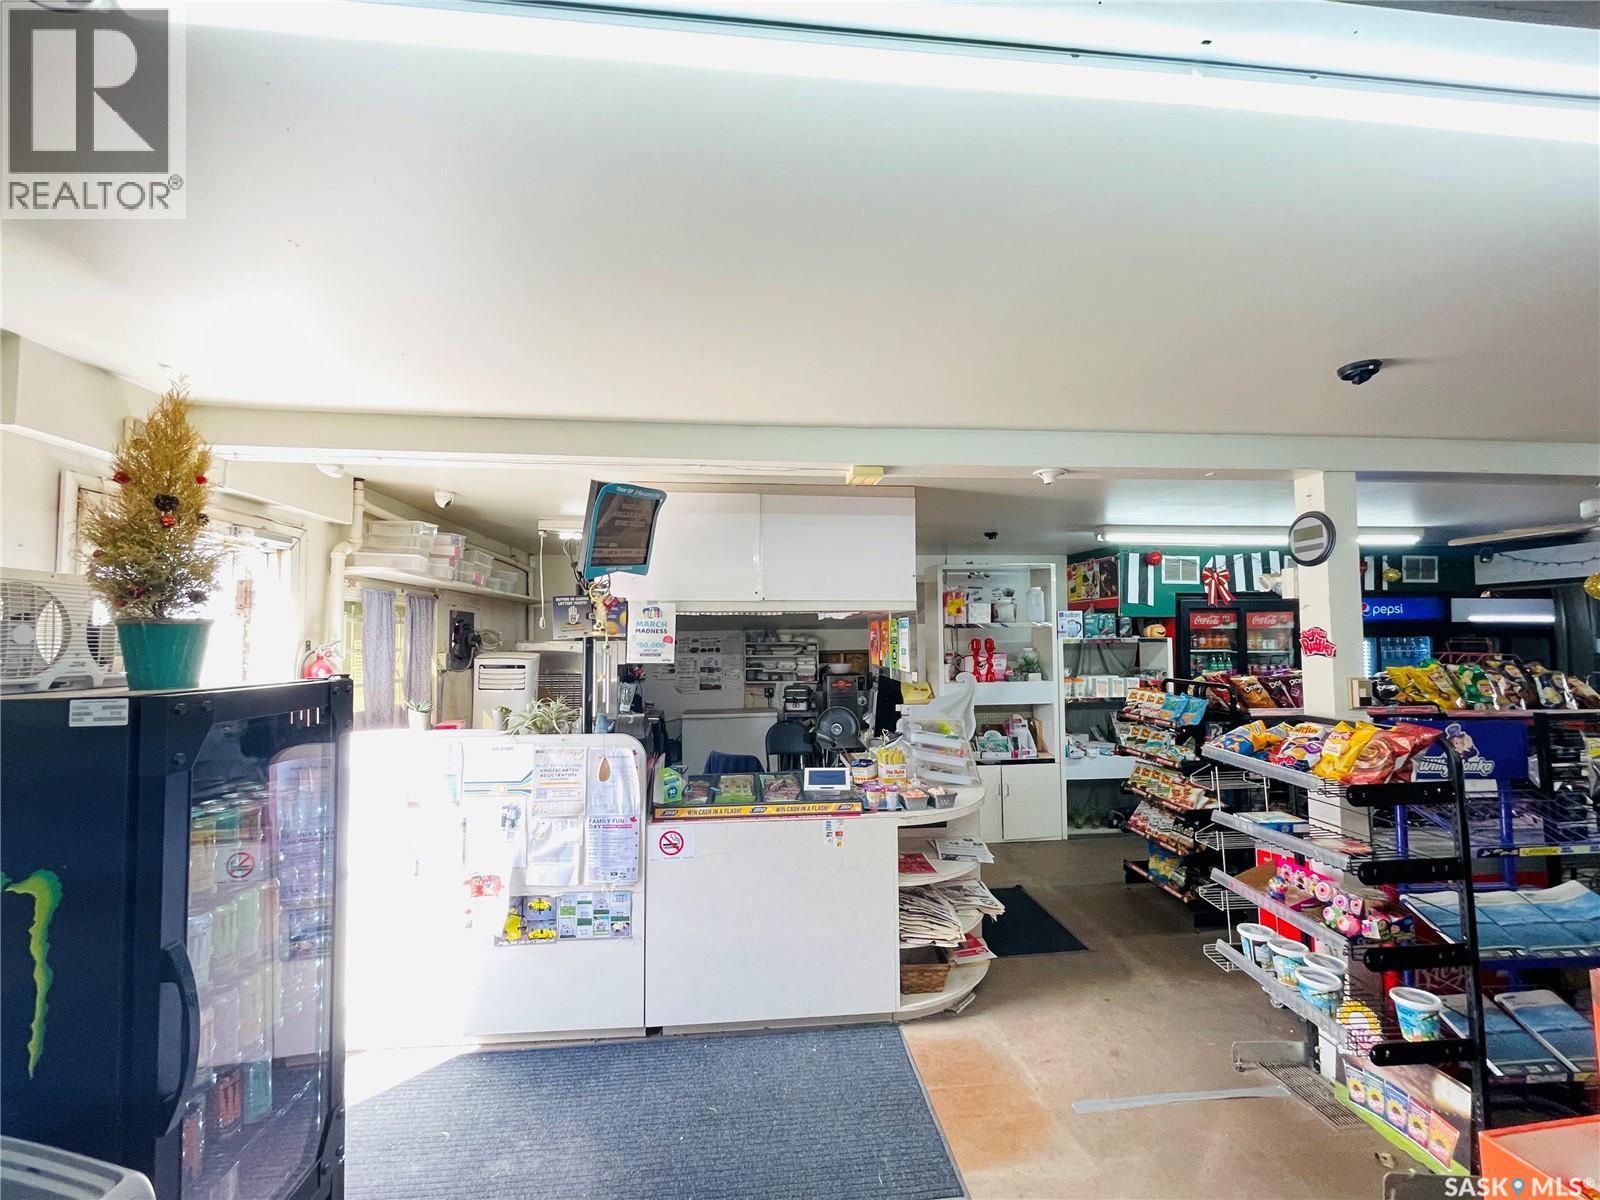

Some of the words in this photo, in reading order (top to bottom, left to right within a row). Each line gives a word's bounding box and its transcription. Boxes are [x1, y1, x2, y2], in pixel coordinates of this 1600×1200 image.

[1372, 603, 1403, 617] pepsi
[1462, 757, 1494, 775] onka
[698, 808, 712, 816] CASH
[712, 807, 719, 815] IN
[723, 806, 743, 815] FLASH!
[811, 803, 830, 812] FLASH!
